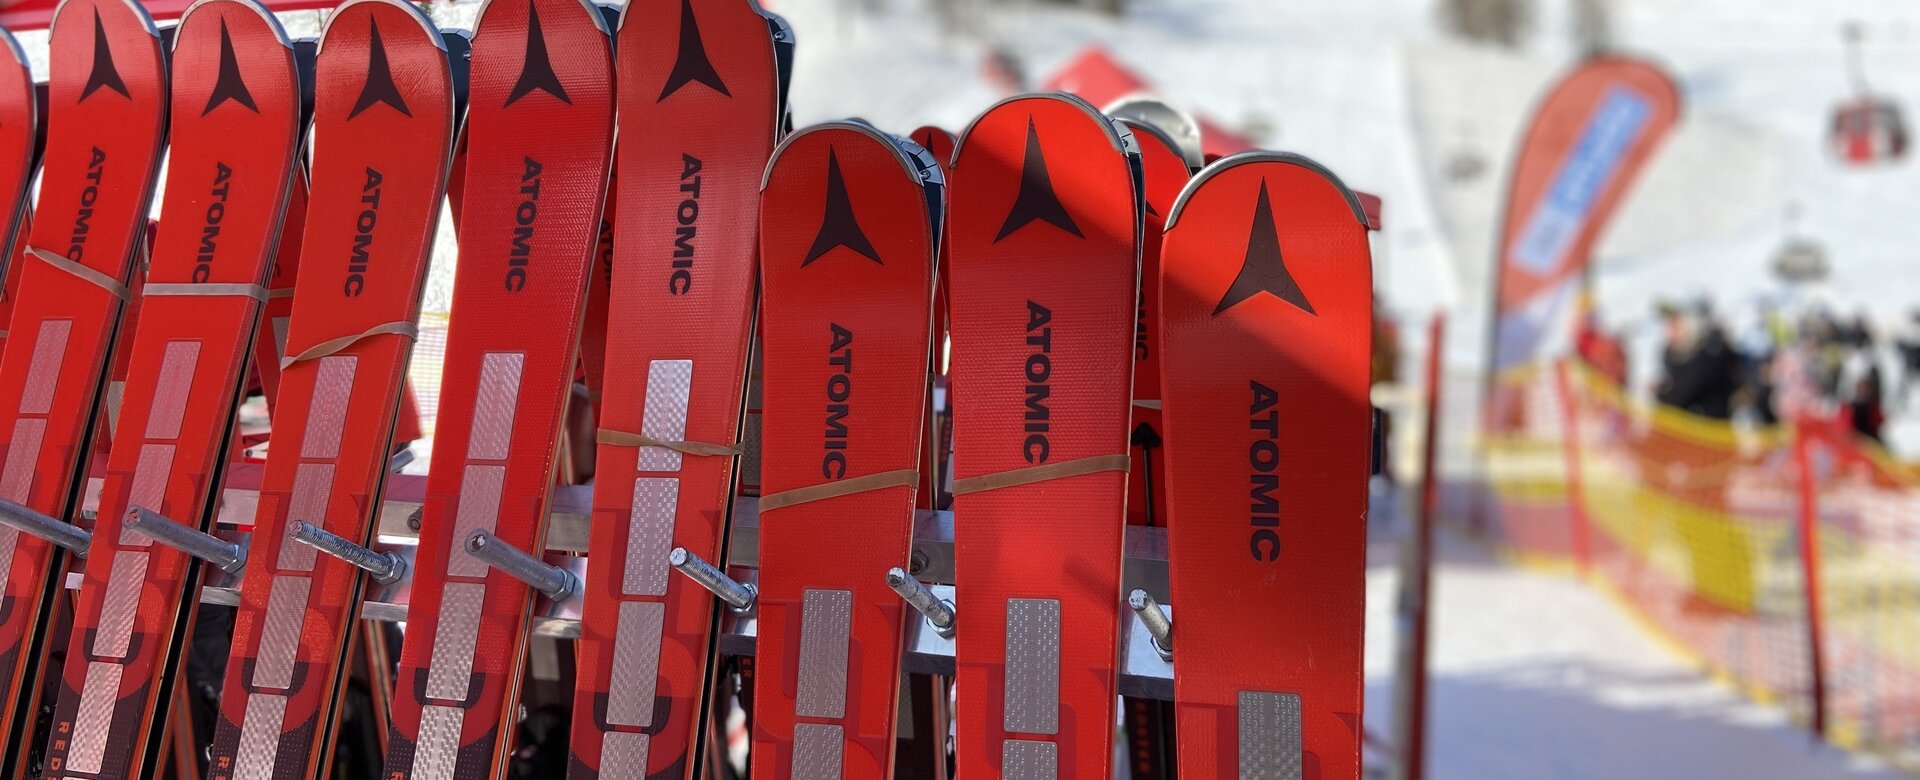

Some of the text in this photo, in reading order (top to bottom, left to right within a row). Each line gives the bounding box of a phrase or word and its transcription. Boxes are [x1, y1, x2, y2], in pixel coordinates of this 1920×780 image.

[67, 146, 106, 263] ATOMIC
[192, 161, 232, 284] ATOMIC
[344, 166, 383, 297] ATOMIC
[505, 156, 543, 292] ATOMIC
[669, 153, 702, 296] ATOMIC
[822, 322, 853, 479] ATOMIC
[1024, 299, 1052, 464] ATOMIC
[1250, 379, 1281, 562] ATOMIC
